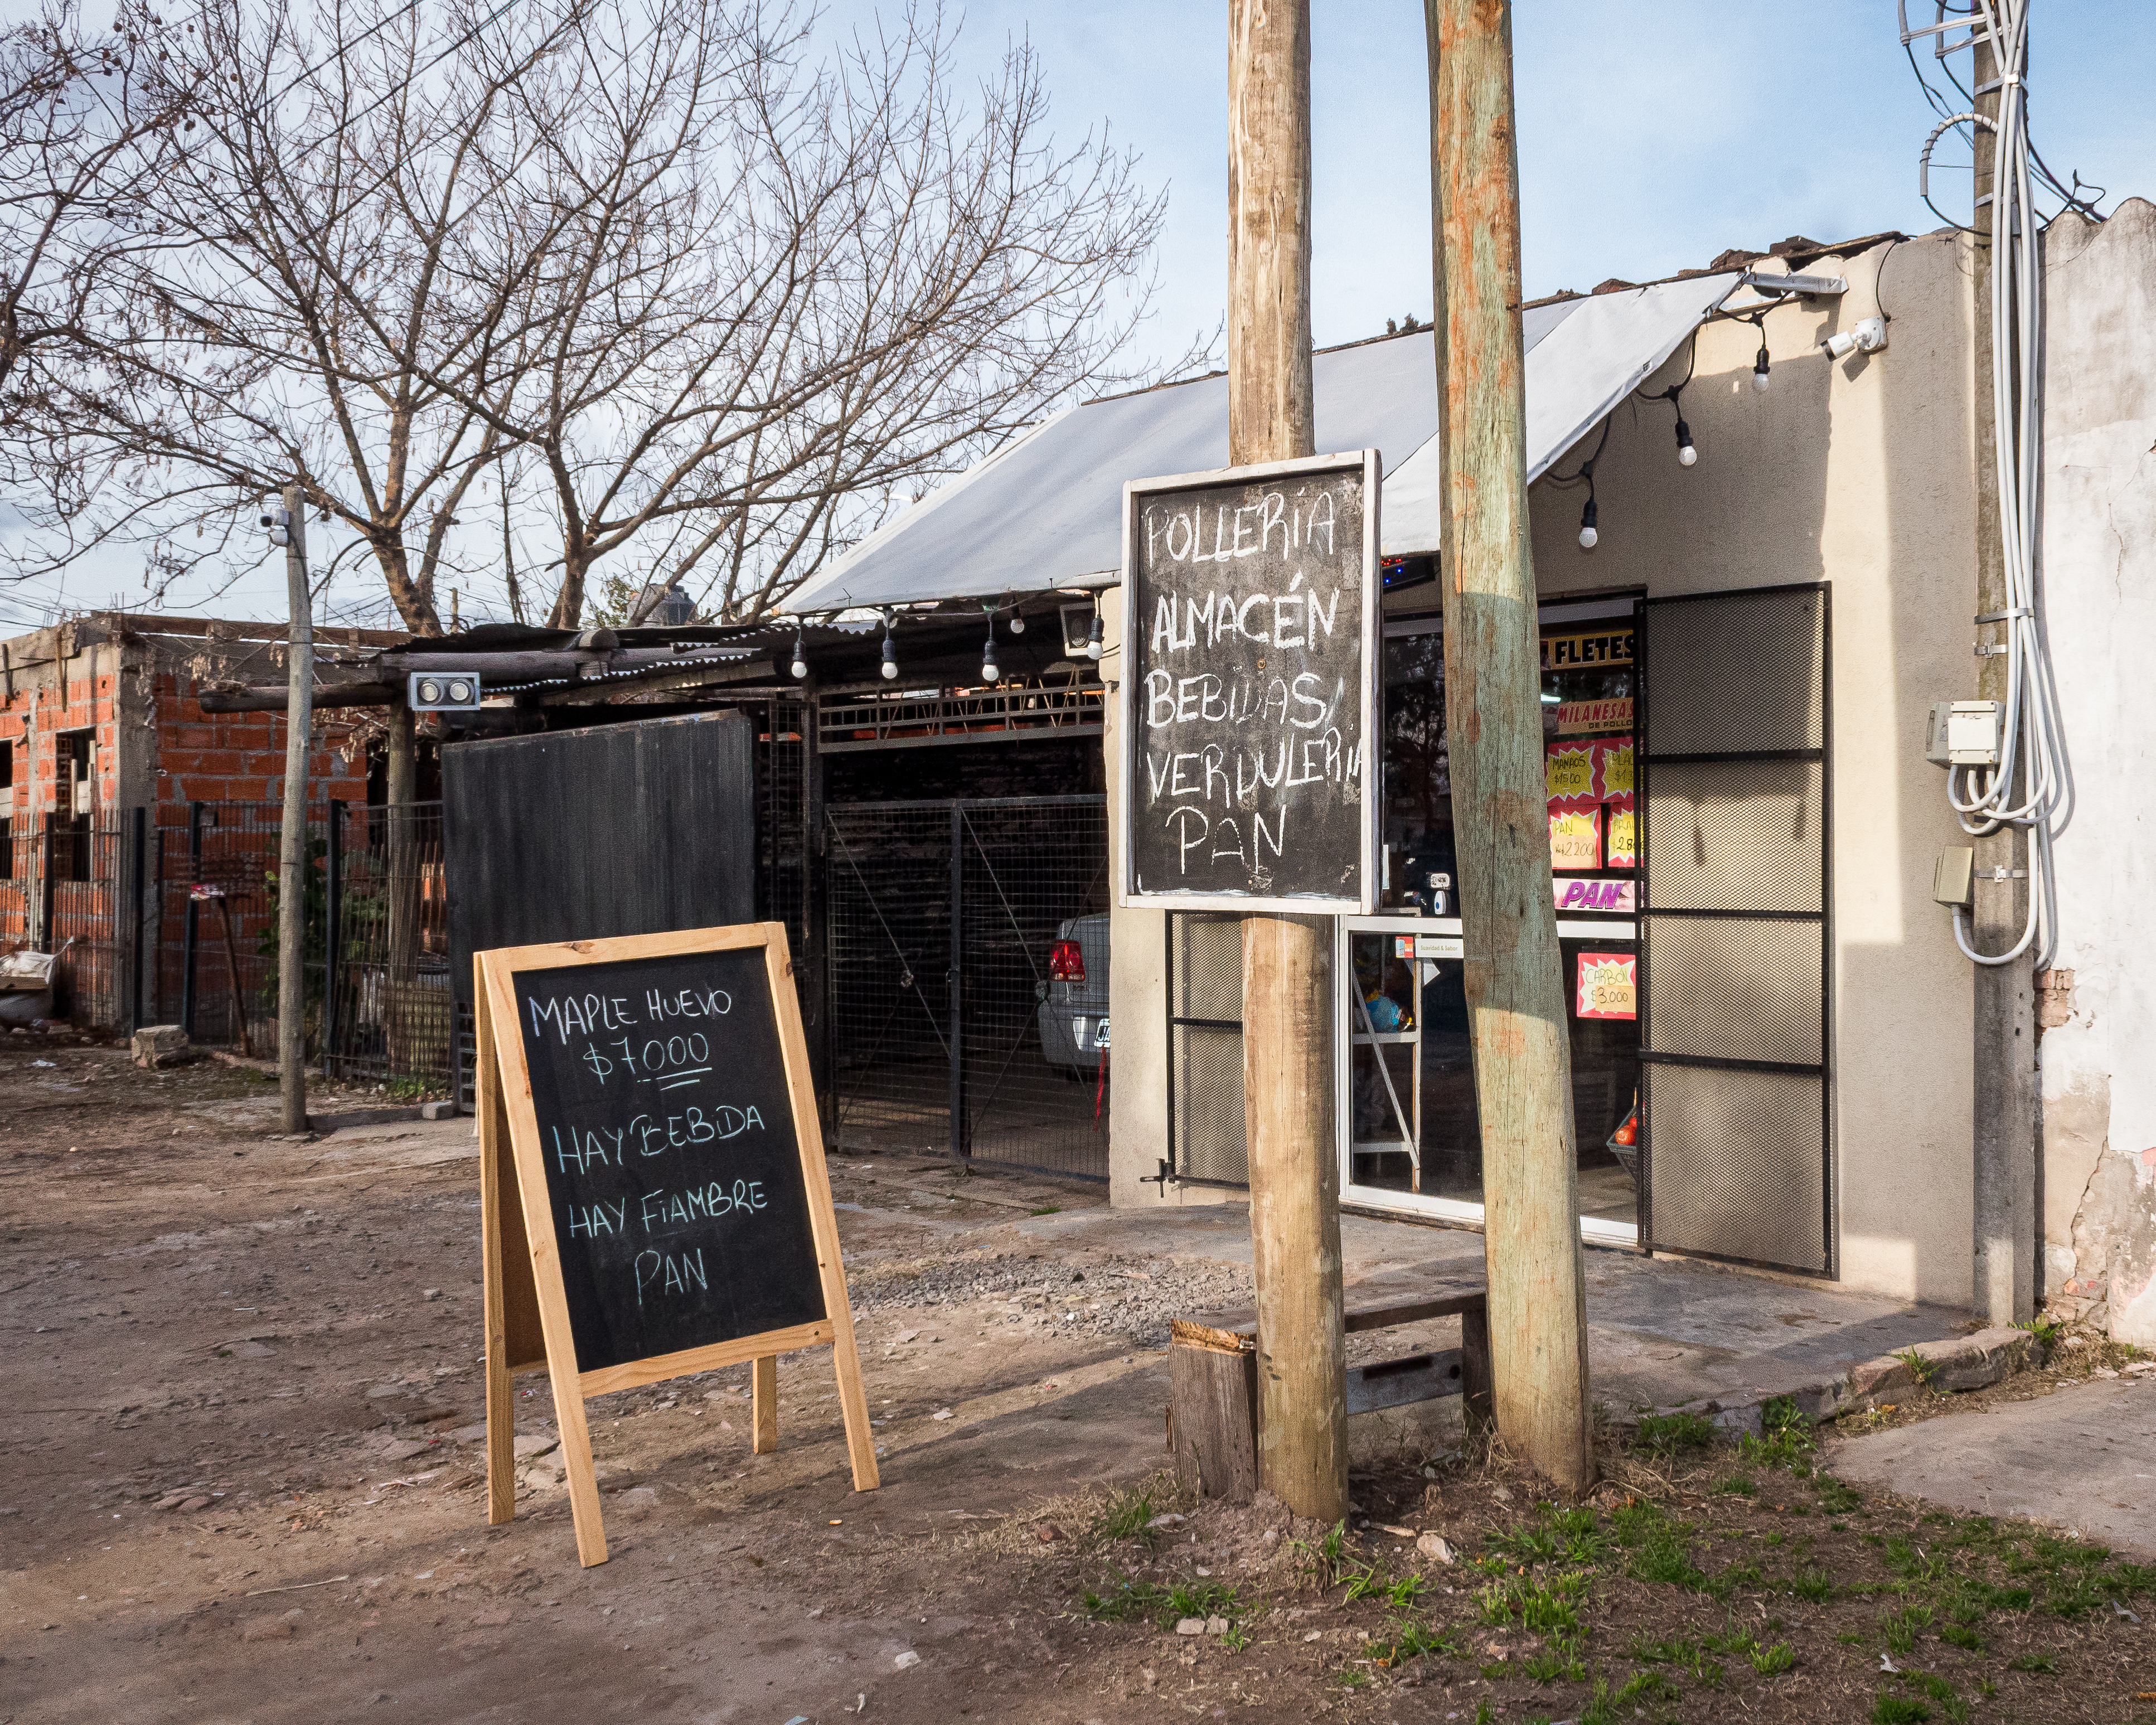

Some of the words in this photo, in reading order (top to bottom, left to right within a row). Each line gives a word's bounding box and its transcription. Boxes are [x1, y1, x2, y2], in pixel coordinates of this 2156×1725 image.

[1141, 487, 1335, 569] POLLERÍA
[1151, 570, 1340, 653] ALMACÉN
[1165, 804, 1286, 875] PAN
[1554, 820, 1572, 836] PAN
[1561, 881, 1624, 909] PAN
[529, 994, 638, 1045] MAPLE
[647, 989, 731, 1021] HUEVO
[553, 1126, 622, 1175] HAY
[570, 1197, 624, 1238] HAY
[635, 1248, 708, 1305] PAN
